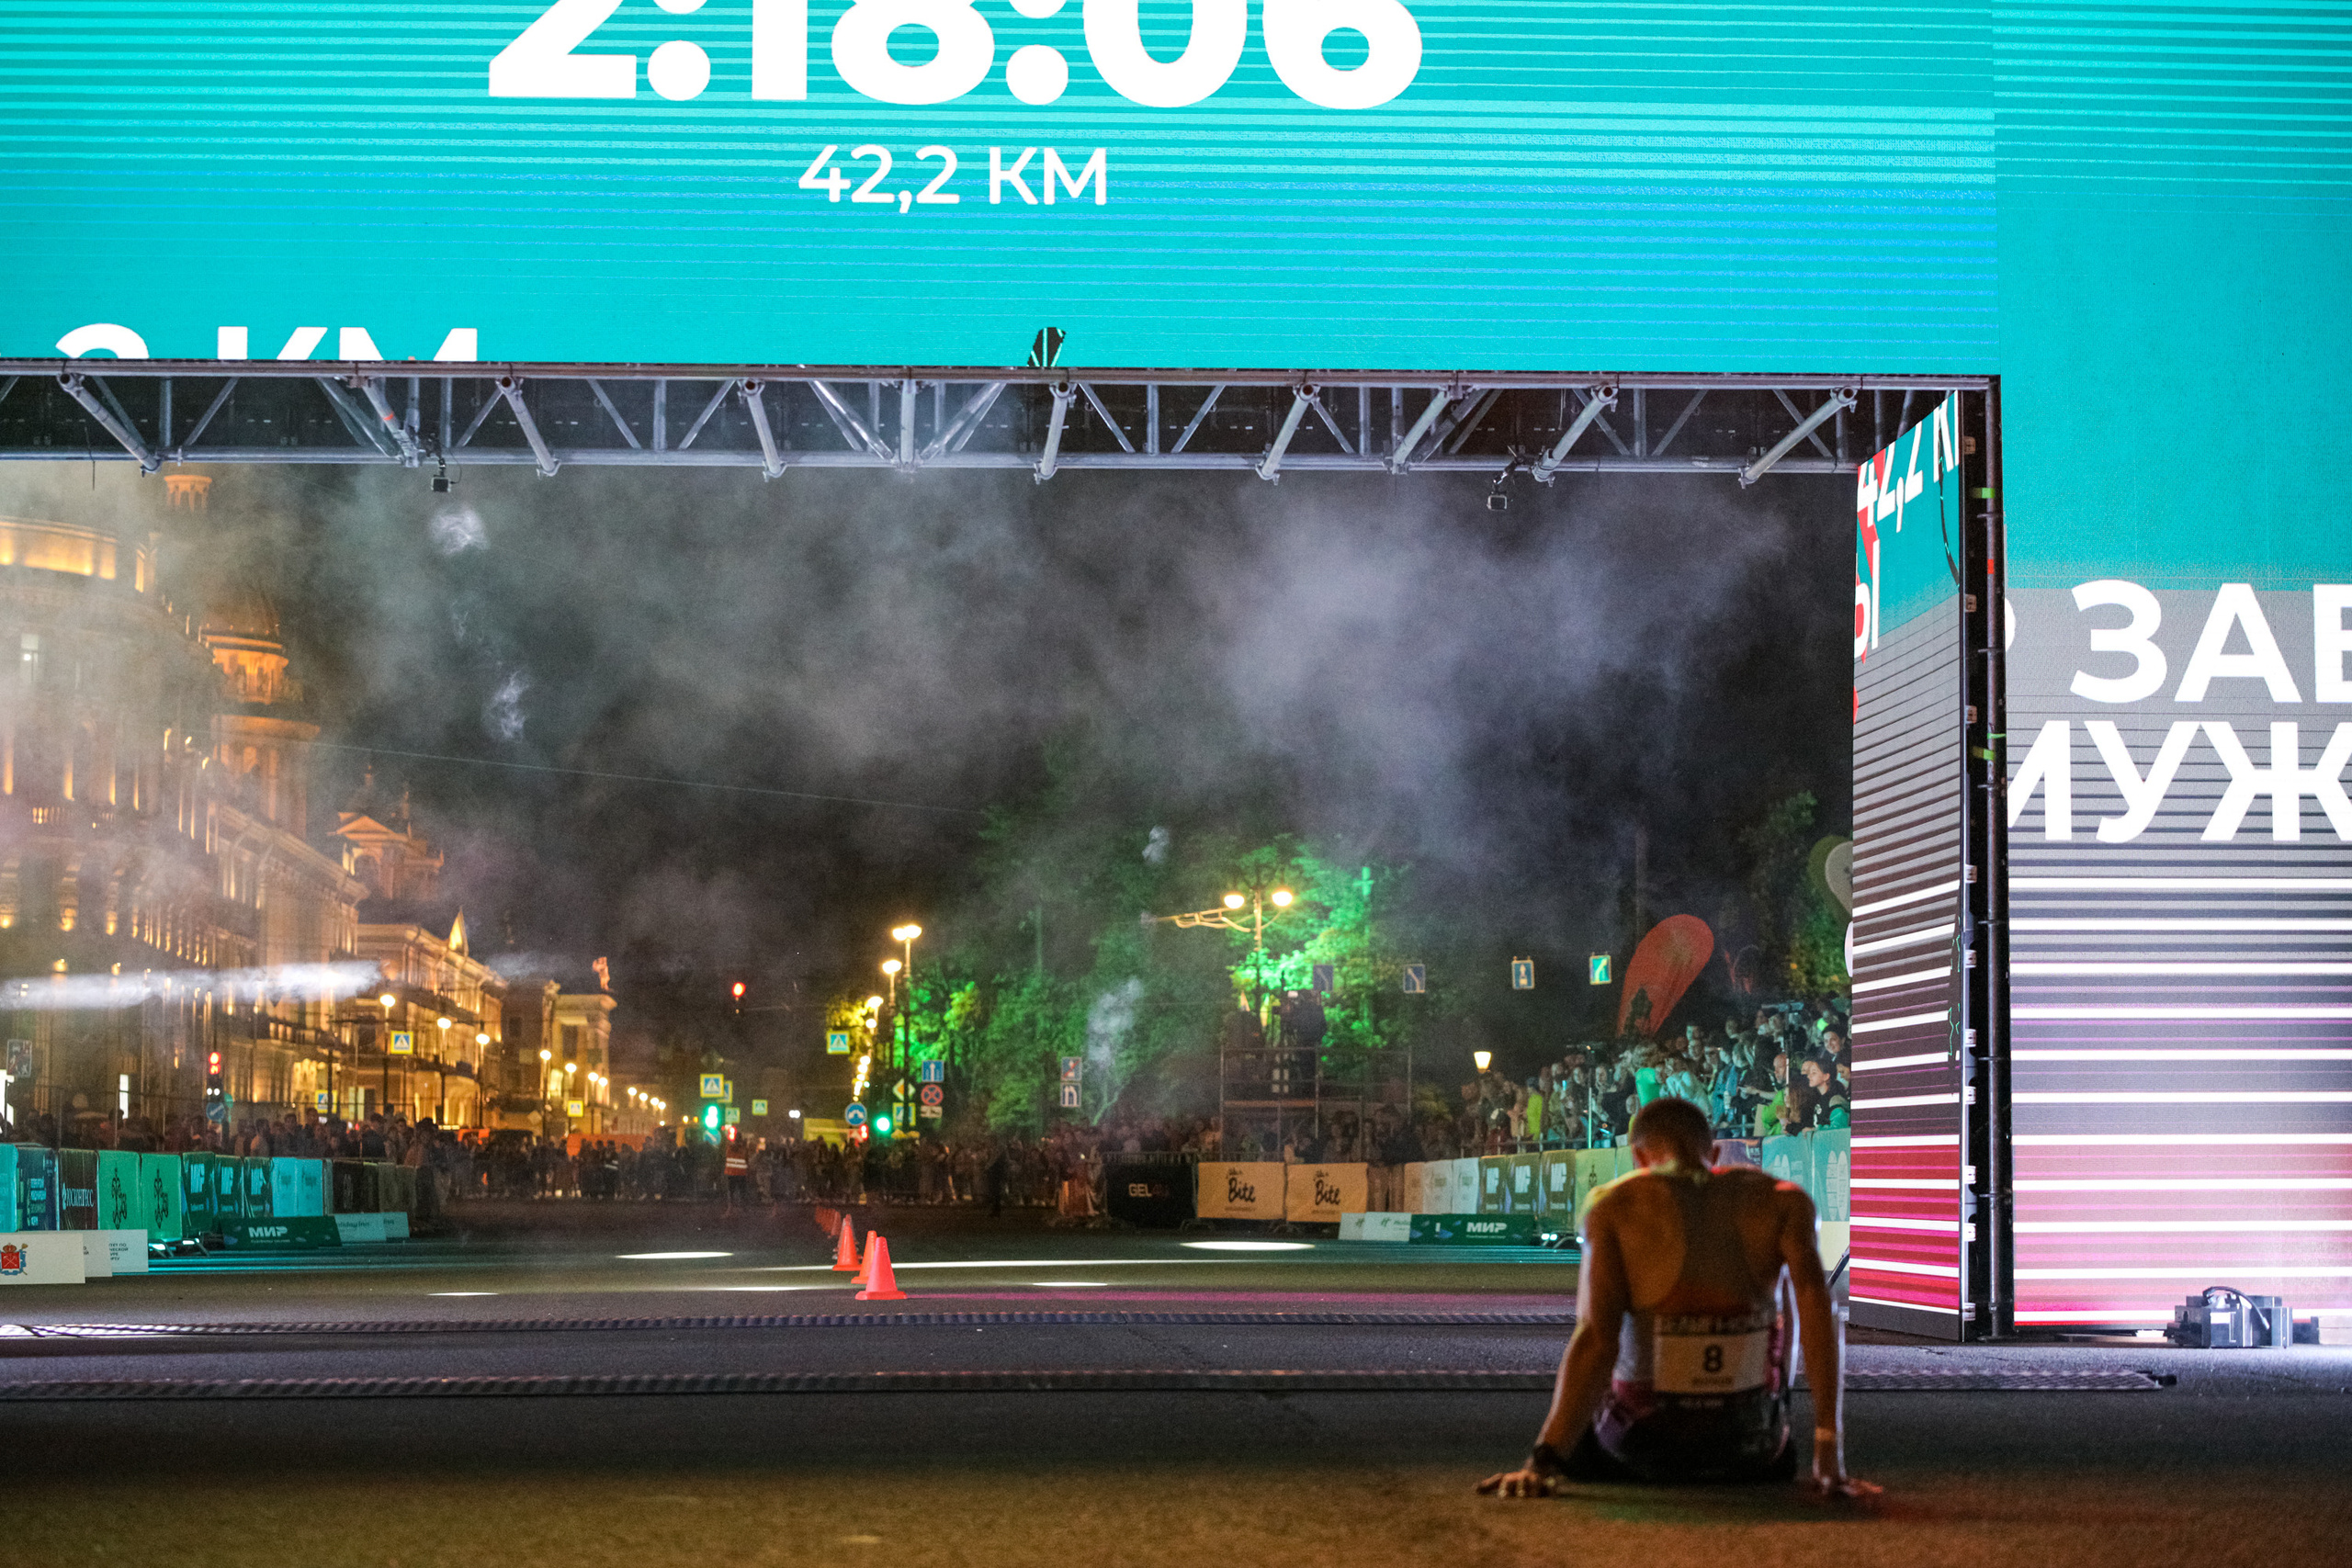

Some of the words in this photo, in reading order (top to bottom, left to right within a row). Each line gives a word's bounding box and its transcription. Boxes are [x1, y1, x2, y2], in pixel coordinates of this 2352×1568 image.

[799, 144, 961, 214] 42,2
[989, 147, 1108, 206] КМ
[1228, 1177, 1256, 1203] Bite
[1315, 1179, 1340, 1206] Bite
[248, 1225, 288, 1238] МИР
[1466, 1222, 1508, 1233] МИР
[1704, 1344, 1724, 1373] 8
